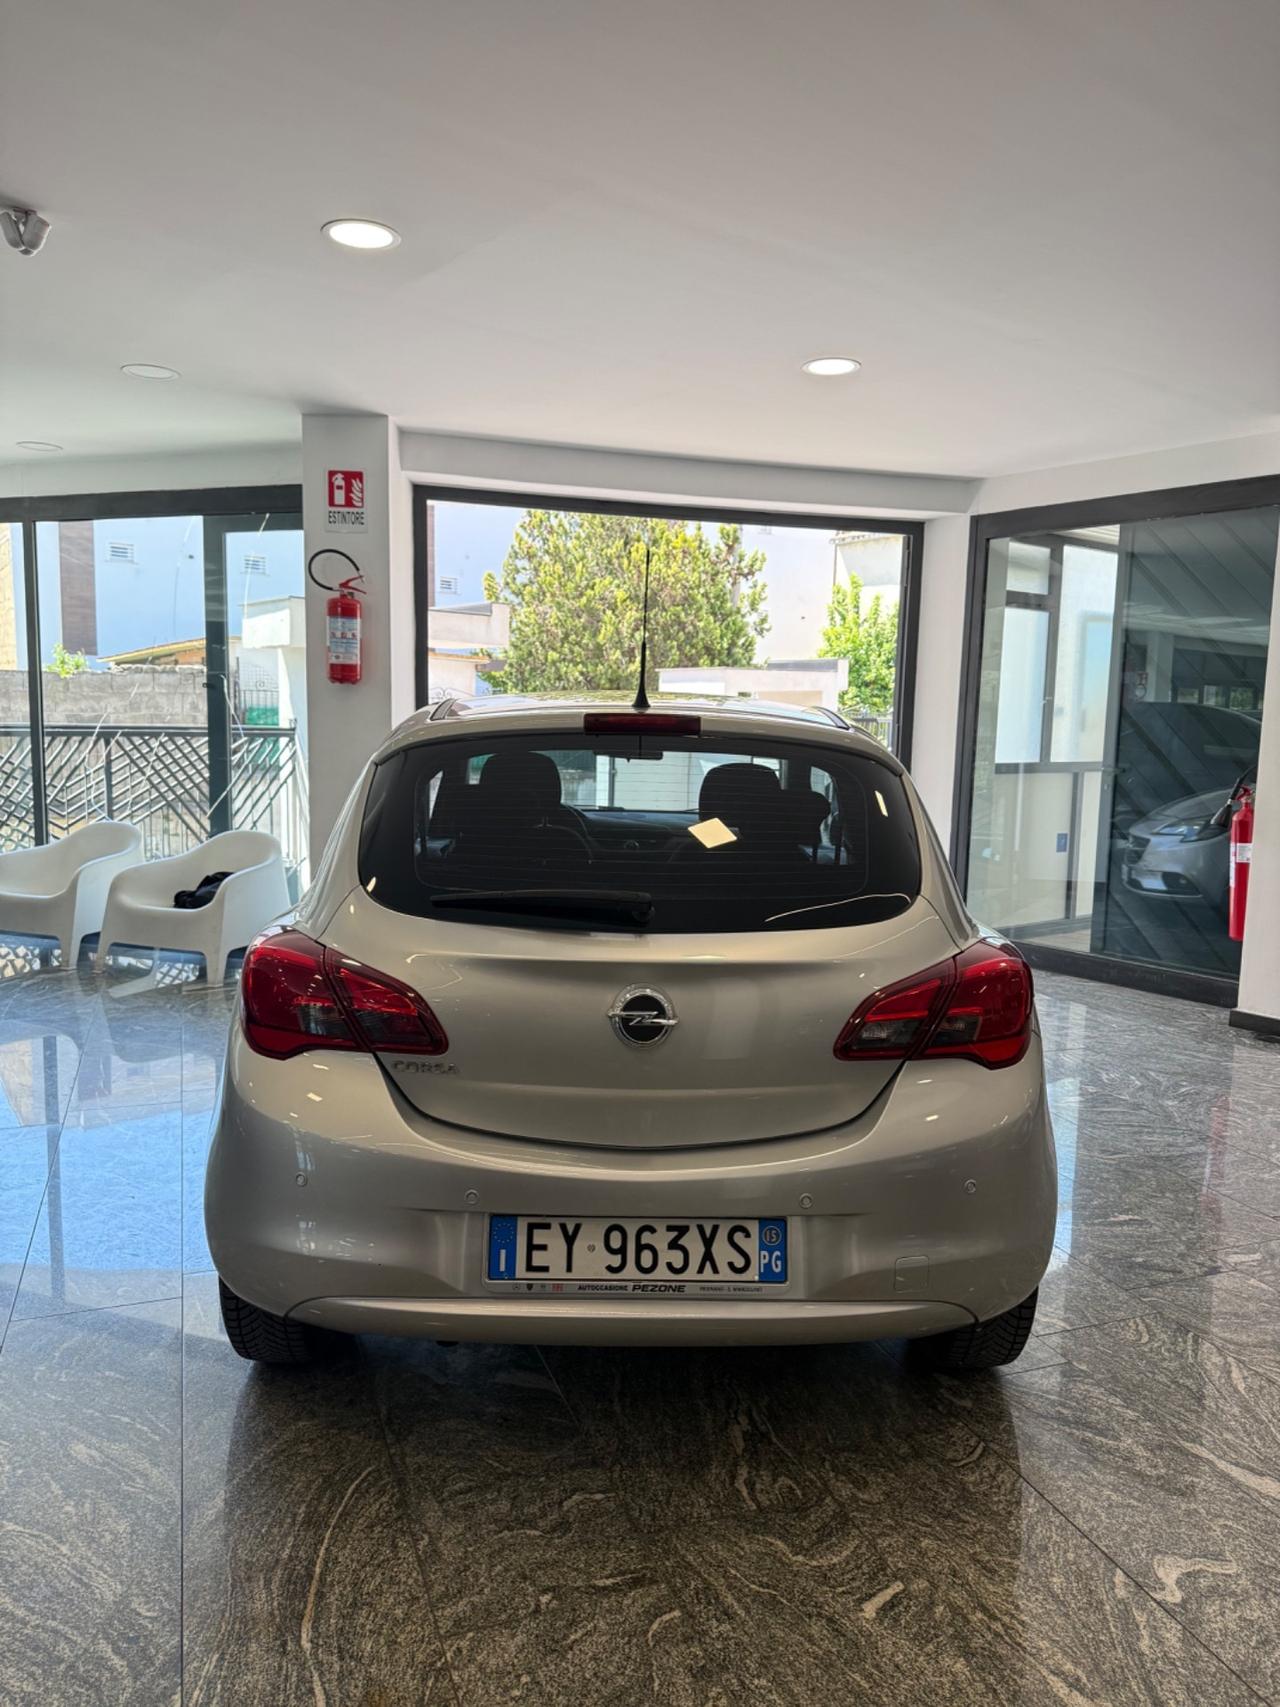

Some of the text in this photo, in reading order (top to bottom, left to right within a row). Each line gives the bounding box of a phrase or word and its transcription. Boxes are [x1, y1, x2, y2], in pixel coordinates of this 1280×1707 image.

[328, 510, 365, 525] ESTINTORE
[760, 1250, 782, 1273] PG
[631, 1283, 686, 1293] PEZONE
